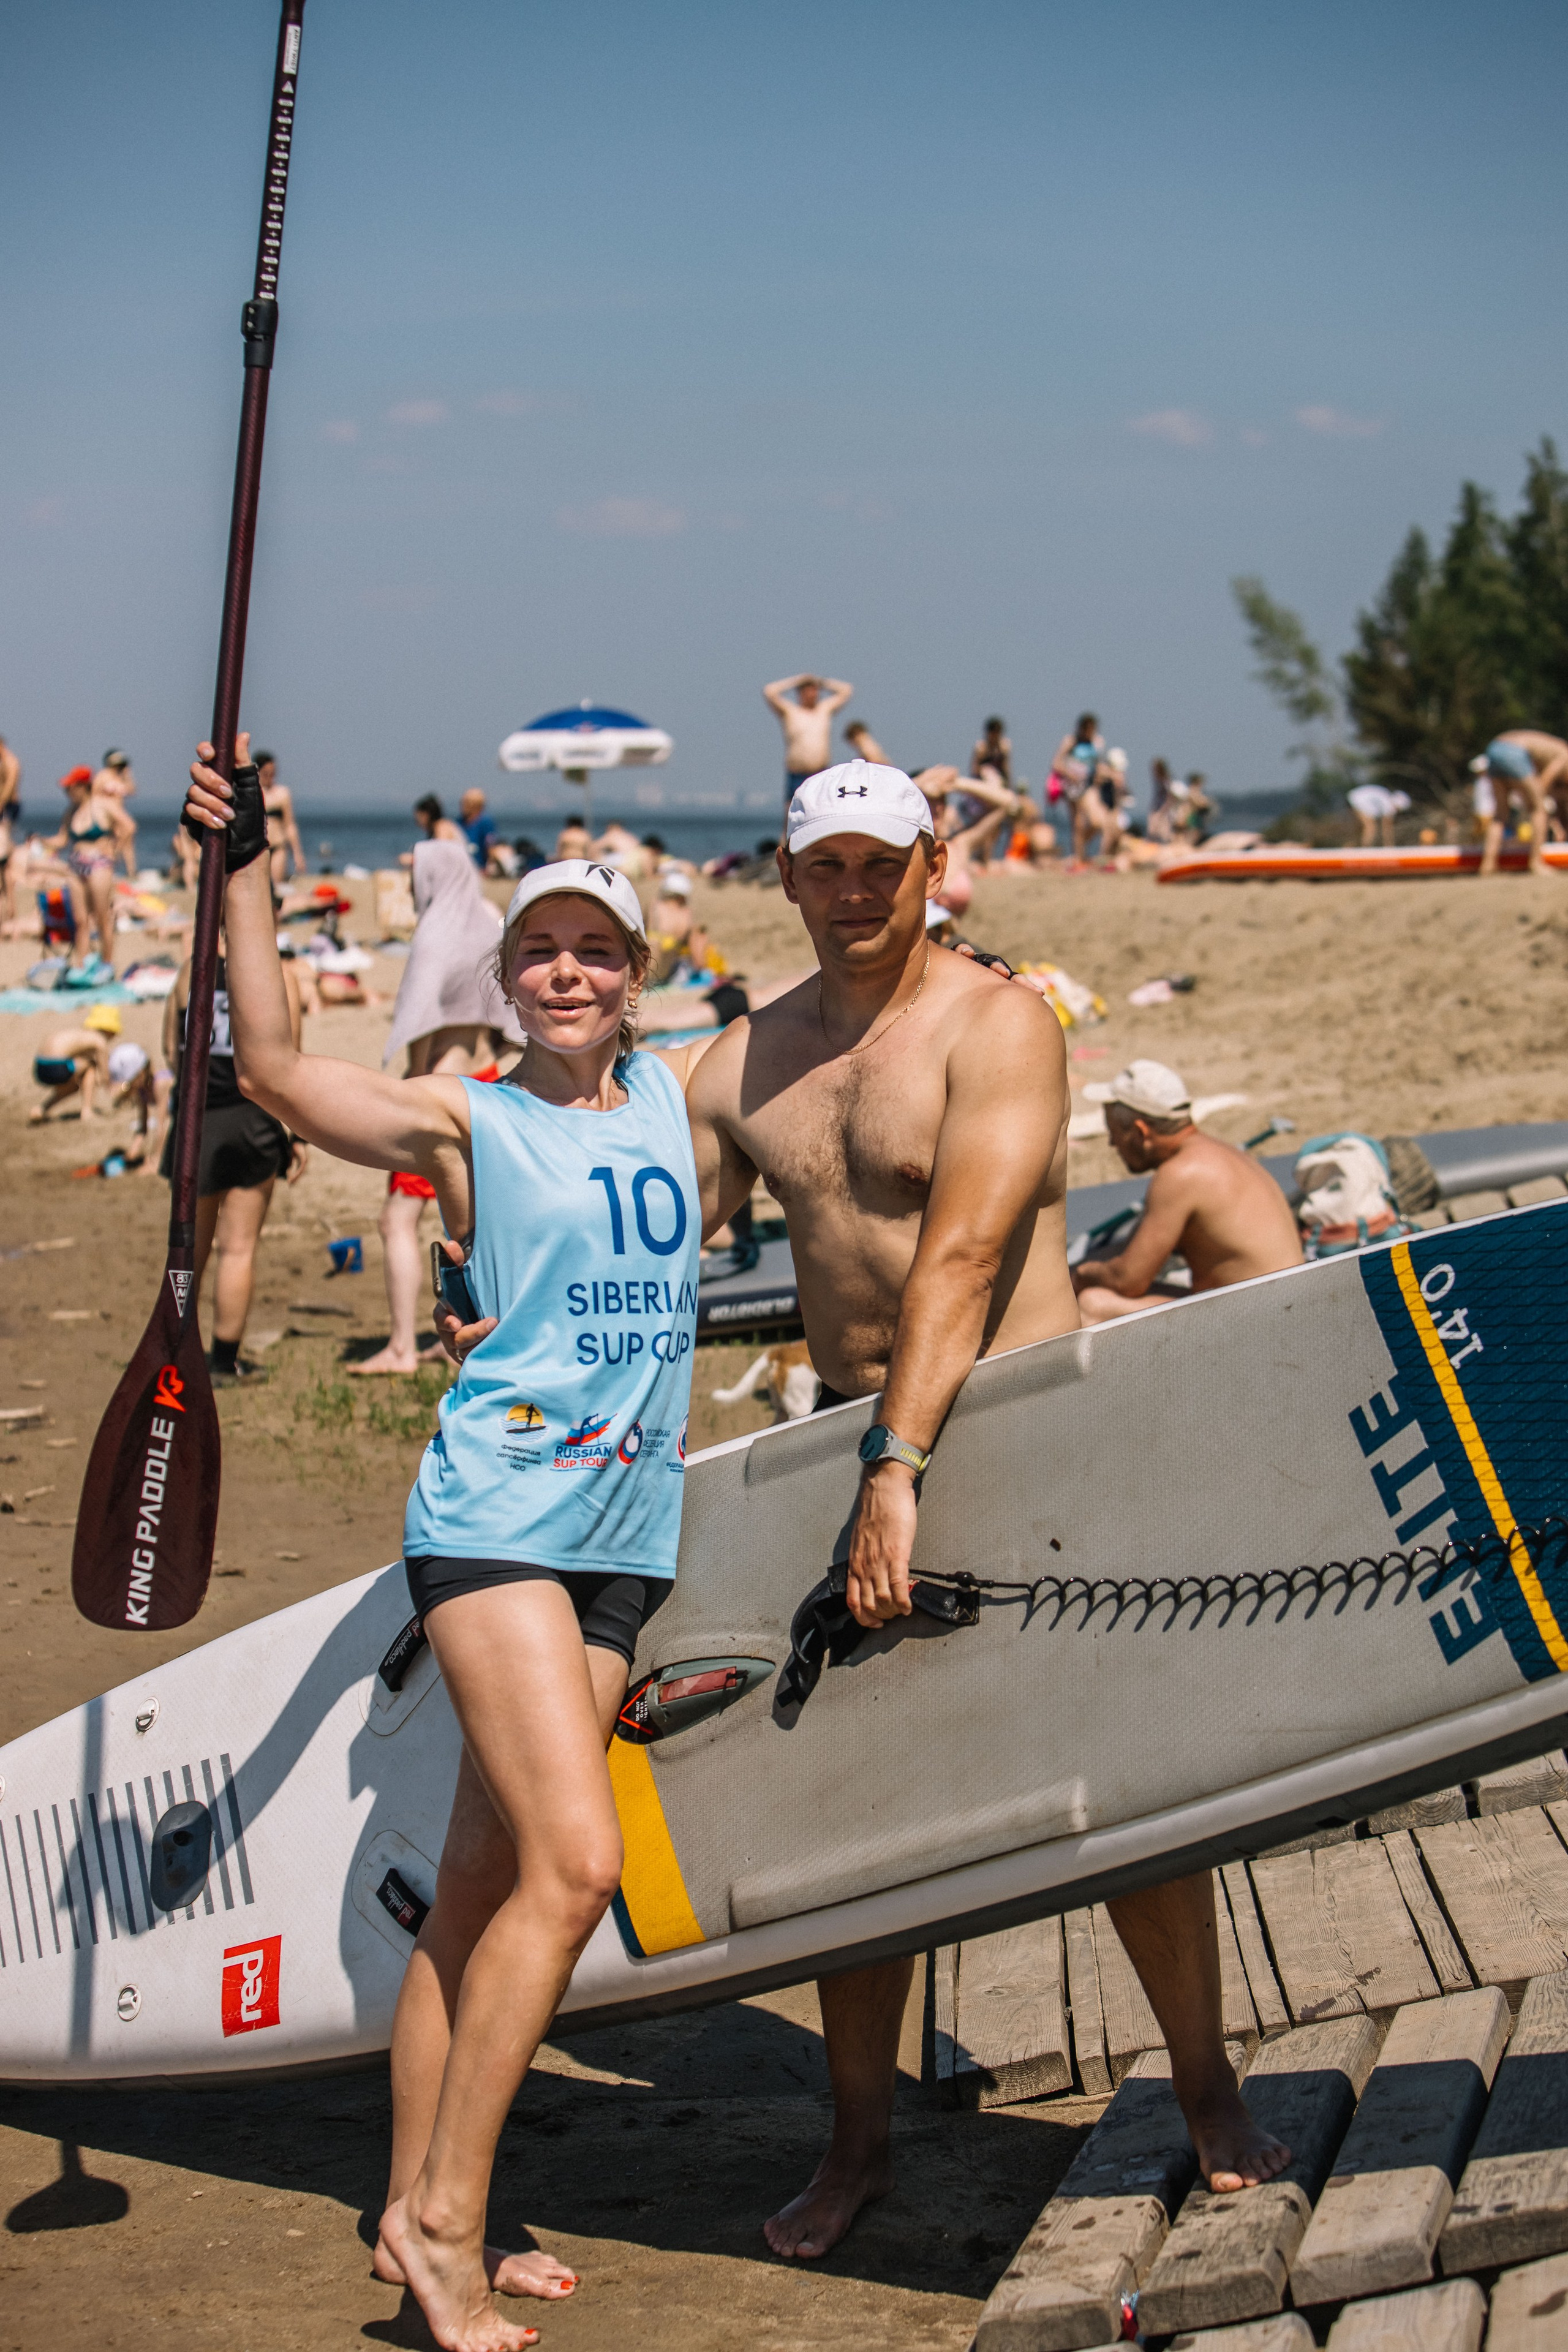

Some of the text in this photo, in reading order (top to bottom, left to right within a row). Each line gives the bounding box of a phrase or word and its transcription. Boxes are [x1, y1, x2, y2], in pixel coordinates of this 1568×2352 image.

[588, 1166, 686, 1256] 10
[567, 1281, 698, 1316] SIBERIAN
[577, 1331, 690, 1365] SUP CUP
[553, 1458, 609, 1468] SUP TOUR
[556, 1446, 612, 1458] RUSSIAN
[126, 1417, 175, 1625] KING PADDLE
[1348, 1371, 1501, 1665] ELITE
[412, 1621, 420, 1637] ed
[398, 1906, 413, 1920] red
[222, 1949, 264, 2023] red
